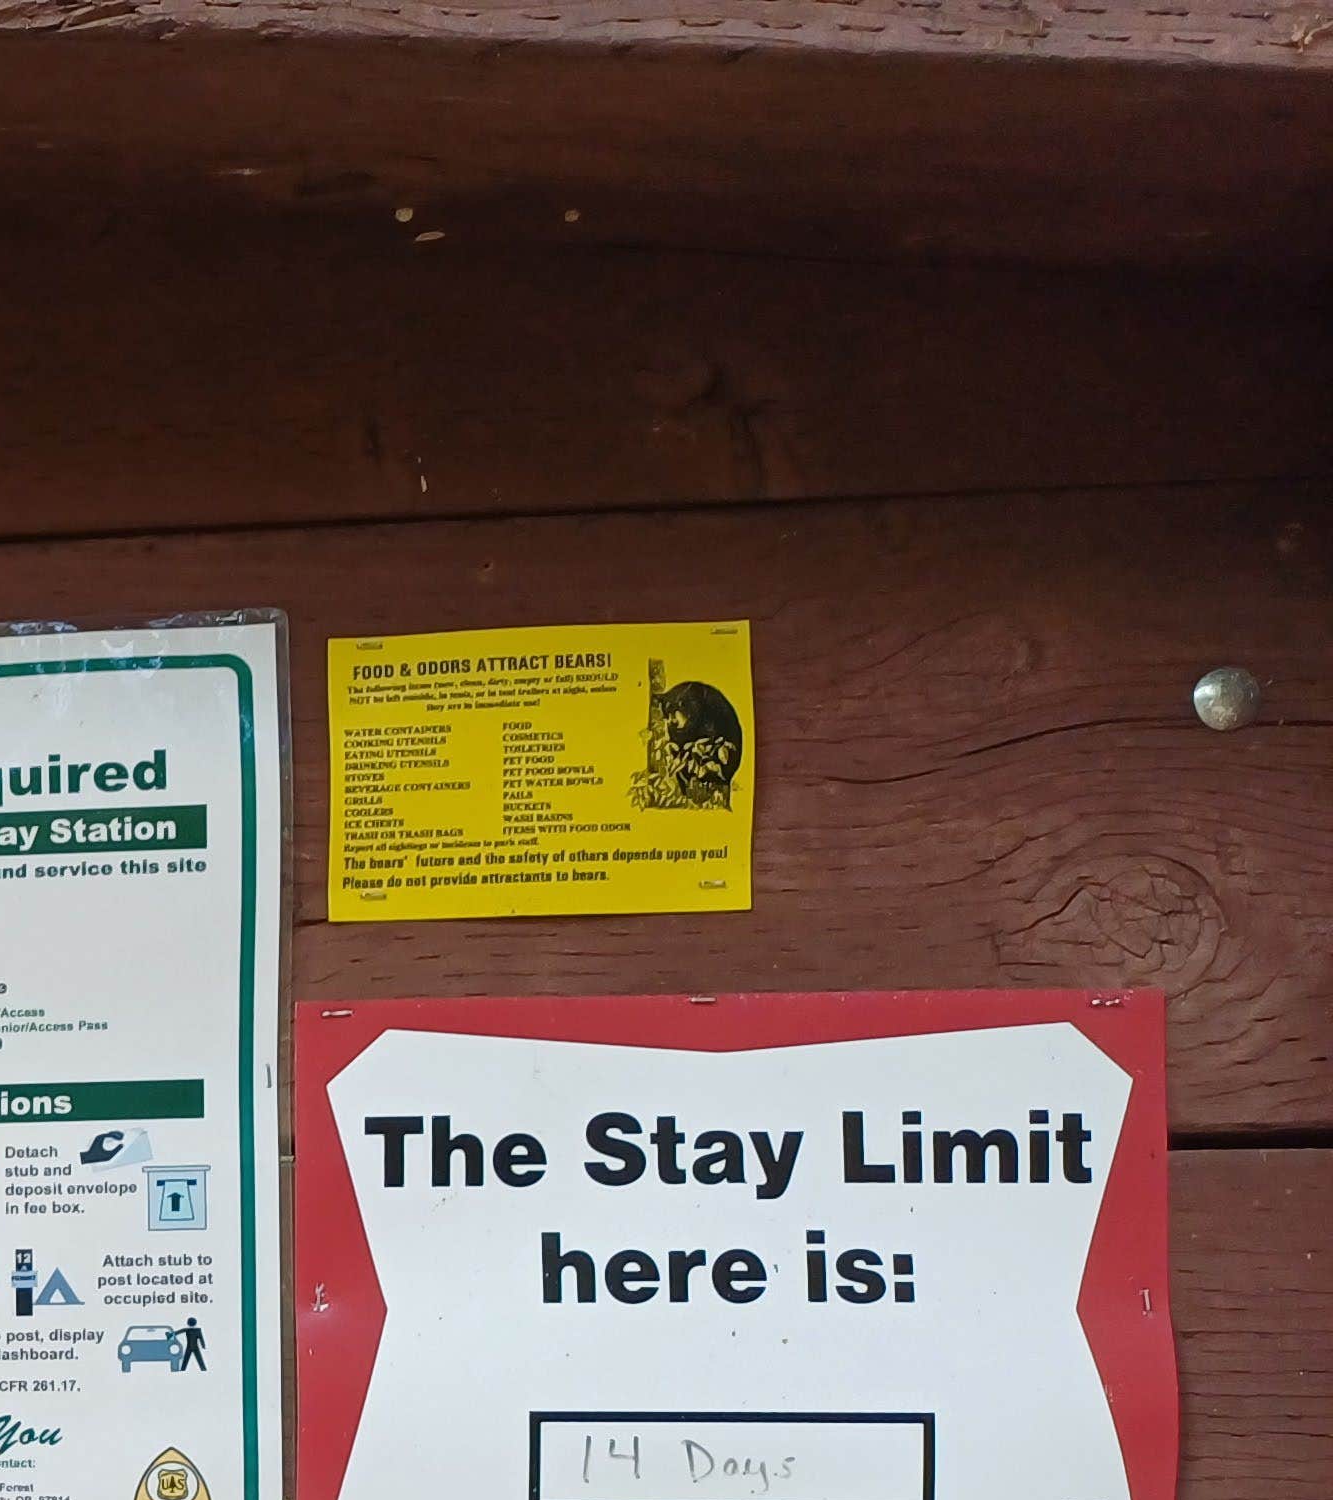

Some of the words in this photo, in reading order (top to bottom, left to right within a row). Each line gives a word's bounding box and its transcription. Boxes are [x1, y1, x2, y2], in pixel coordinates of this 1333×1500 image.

[354, 665, 394, 680] FOOD
[400, 663, 411, 677] &
[417, 659, 470, 675] ODORS
[477, 655, 549, 672] ATTRACT
[555, 654, 611, 668] BEARS!
[50, 816, 176, 843] Station
[35, 862, 112, 878] service
[121, 859, 159, 874] this
[167, 858, 206, 873] site
[365, 1115, 547, 1187] The
[584, 1112, 804, 1199] Stay
[842, 1110, 1092, 1183] Limit
[541, 1232, 767, 1304] here
[806, 1230, 915, 1304] is:
[0, 1381, 27, 1392] CFR
[33, 1380, 80, 1391] 261.17.
[583, 1436, 640, 1483] 14
[681, 1440, 795, 1493] Days
